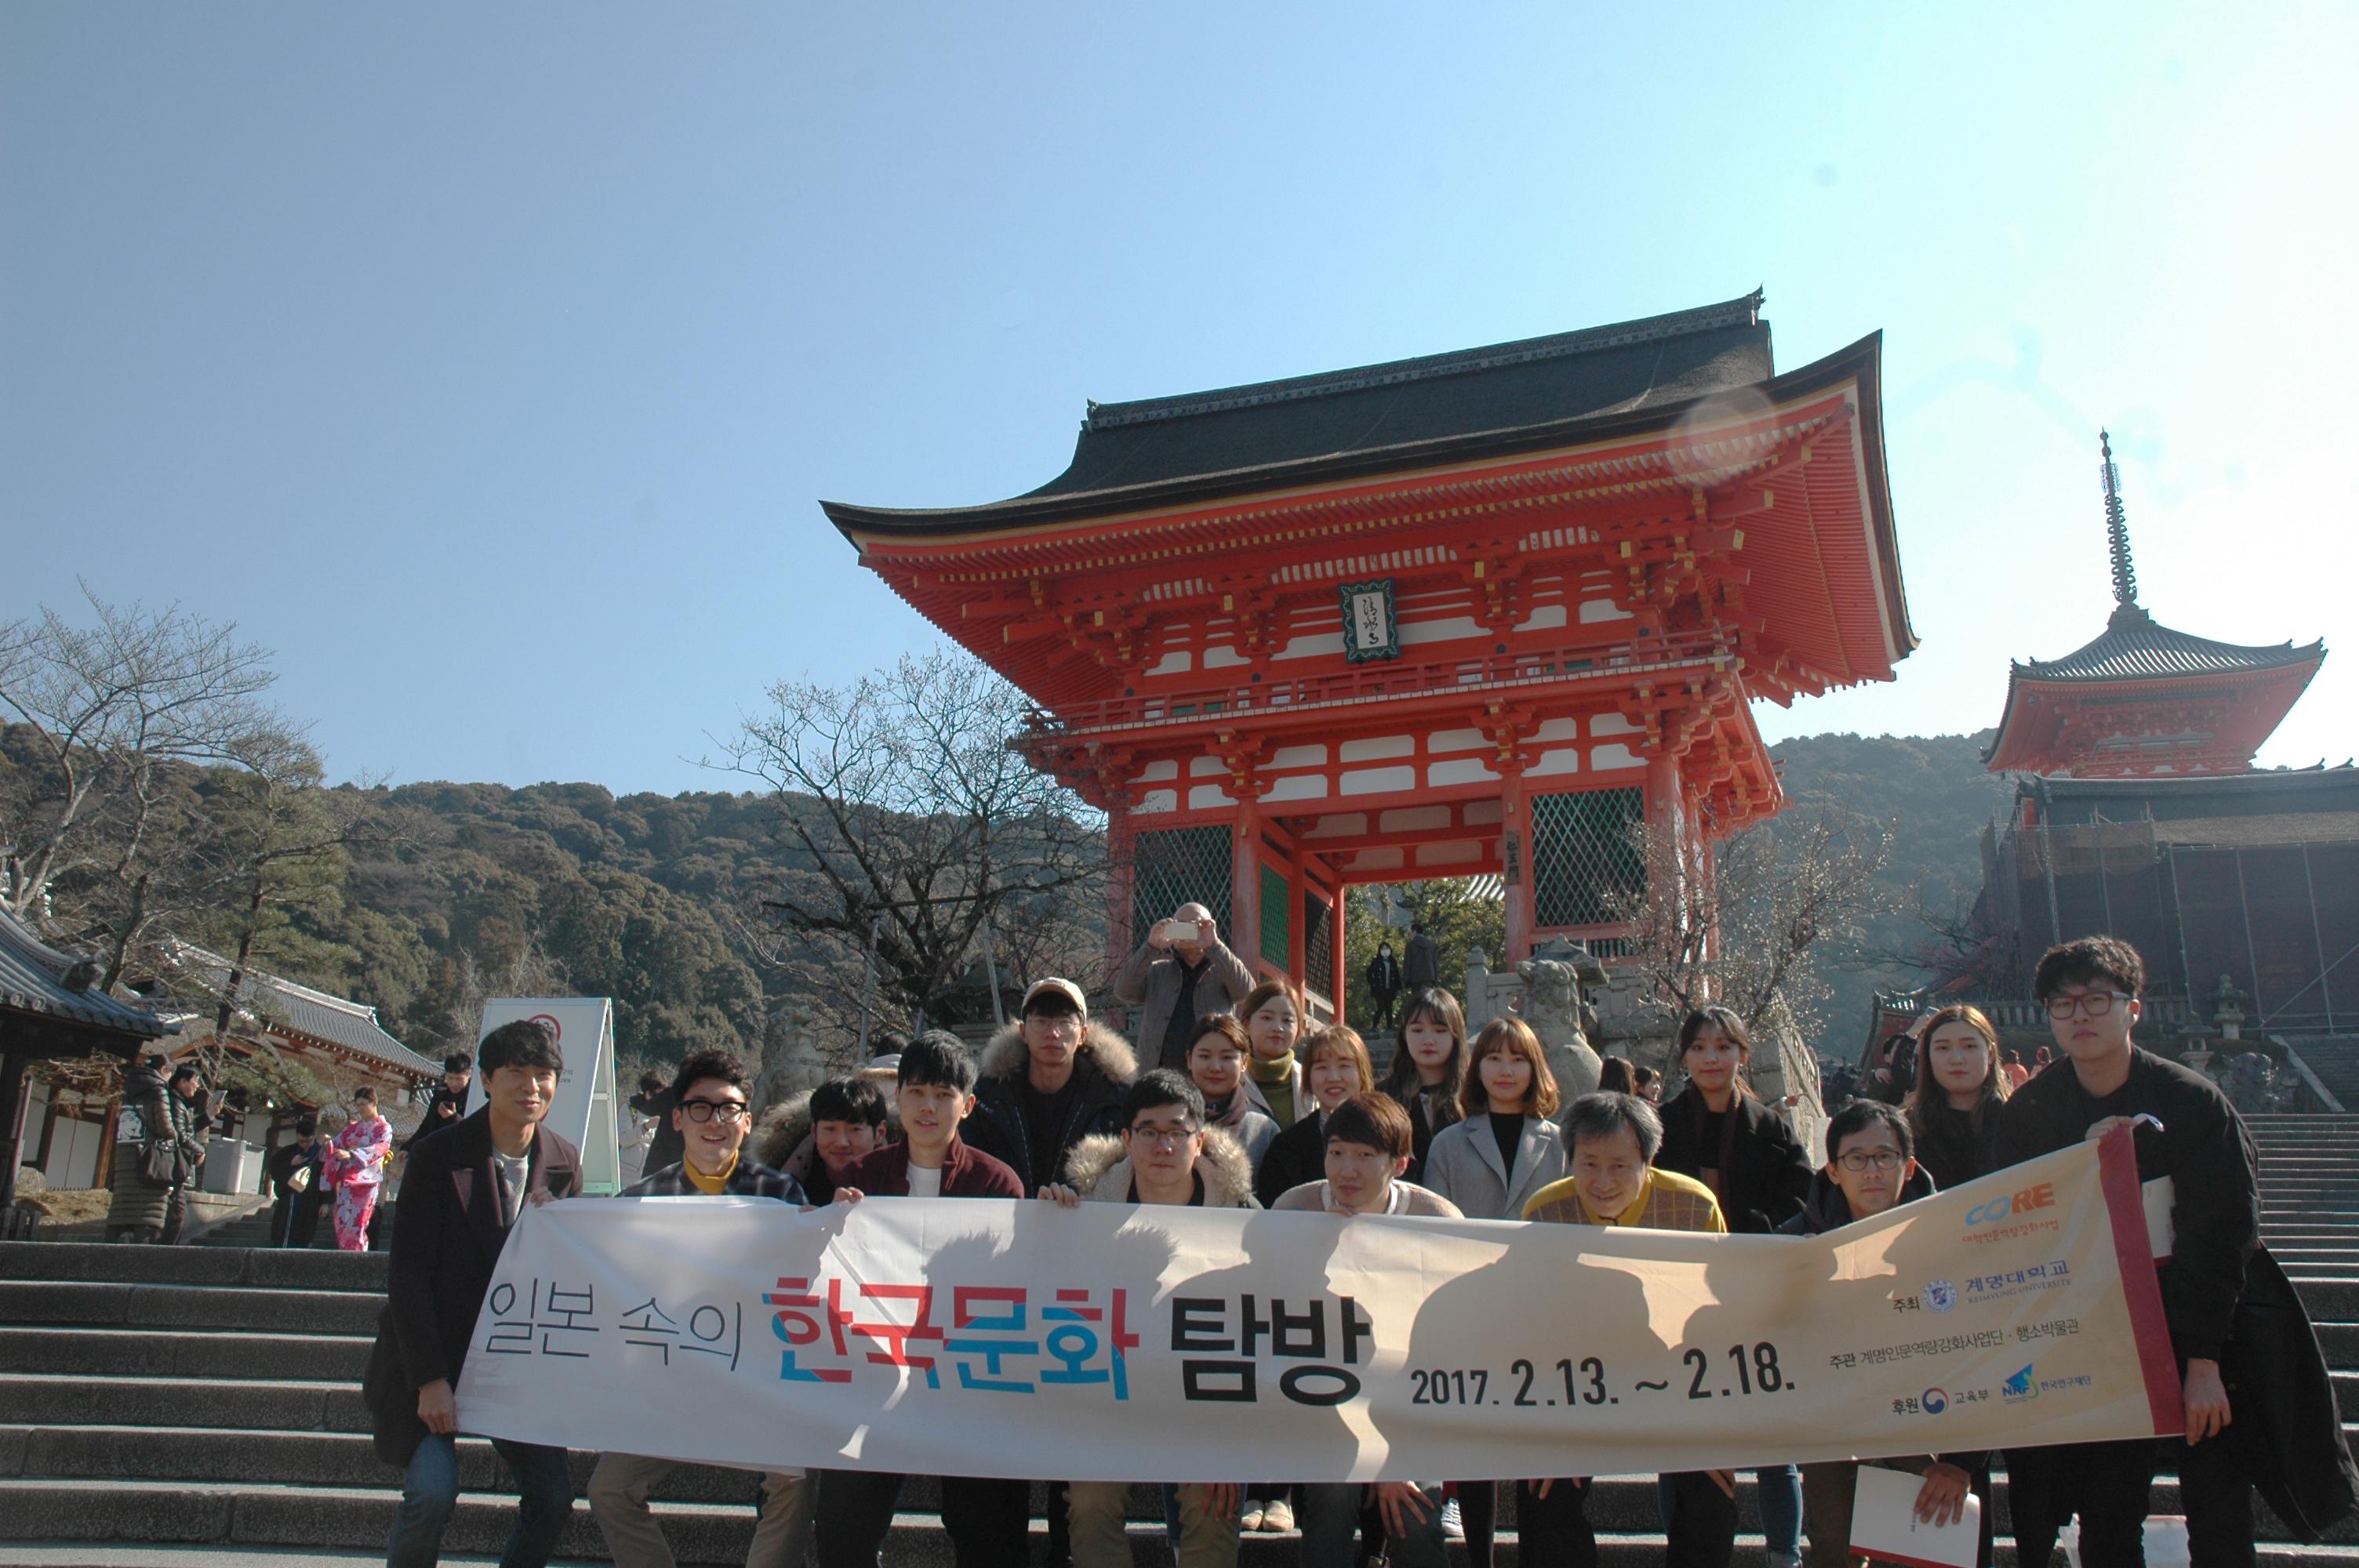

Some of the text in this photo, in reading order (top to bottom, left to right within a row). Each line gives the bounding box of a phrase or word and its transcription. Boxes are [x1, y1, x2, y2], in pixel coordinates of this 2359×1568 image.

[1965, 1181, 2056, 1226] CORE
[1965, 1260, 2070, 1293] 계명대학교
[1892, 1296, 1921, 1313] 주최
[1968, 1290, 2017, 1305] KEIMYUNG
[2018, 1278, 2072, 1294] UNIVERSITY
[485, 1276, 1371, 1406] 일본 속의 한국문화 탐방
[1829, 1352, 1857, 1370] 주관
[1861, 1329, 2004, 1364] 계명인문역량강화사업단
[2016, 1317, 2080, 1342] 행소박물관
[1411, 1368, 1499, 1406] 2017.
[1510, 1356, 1619, 1406] 2.13.
[1682, 1341, 1796, 1399] 2.18.
[2040, 1374, 2092, 1391] 한국연구재단
[1954, 1388, 1990, 1405] 교육부
[2001, 1383, 2030, 1397] NRF
[1892, 1398, 1920, 1415] 후원
